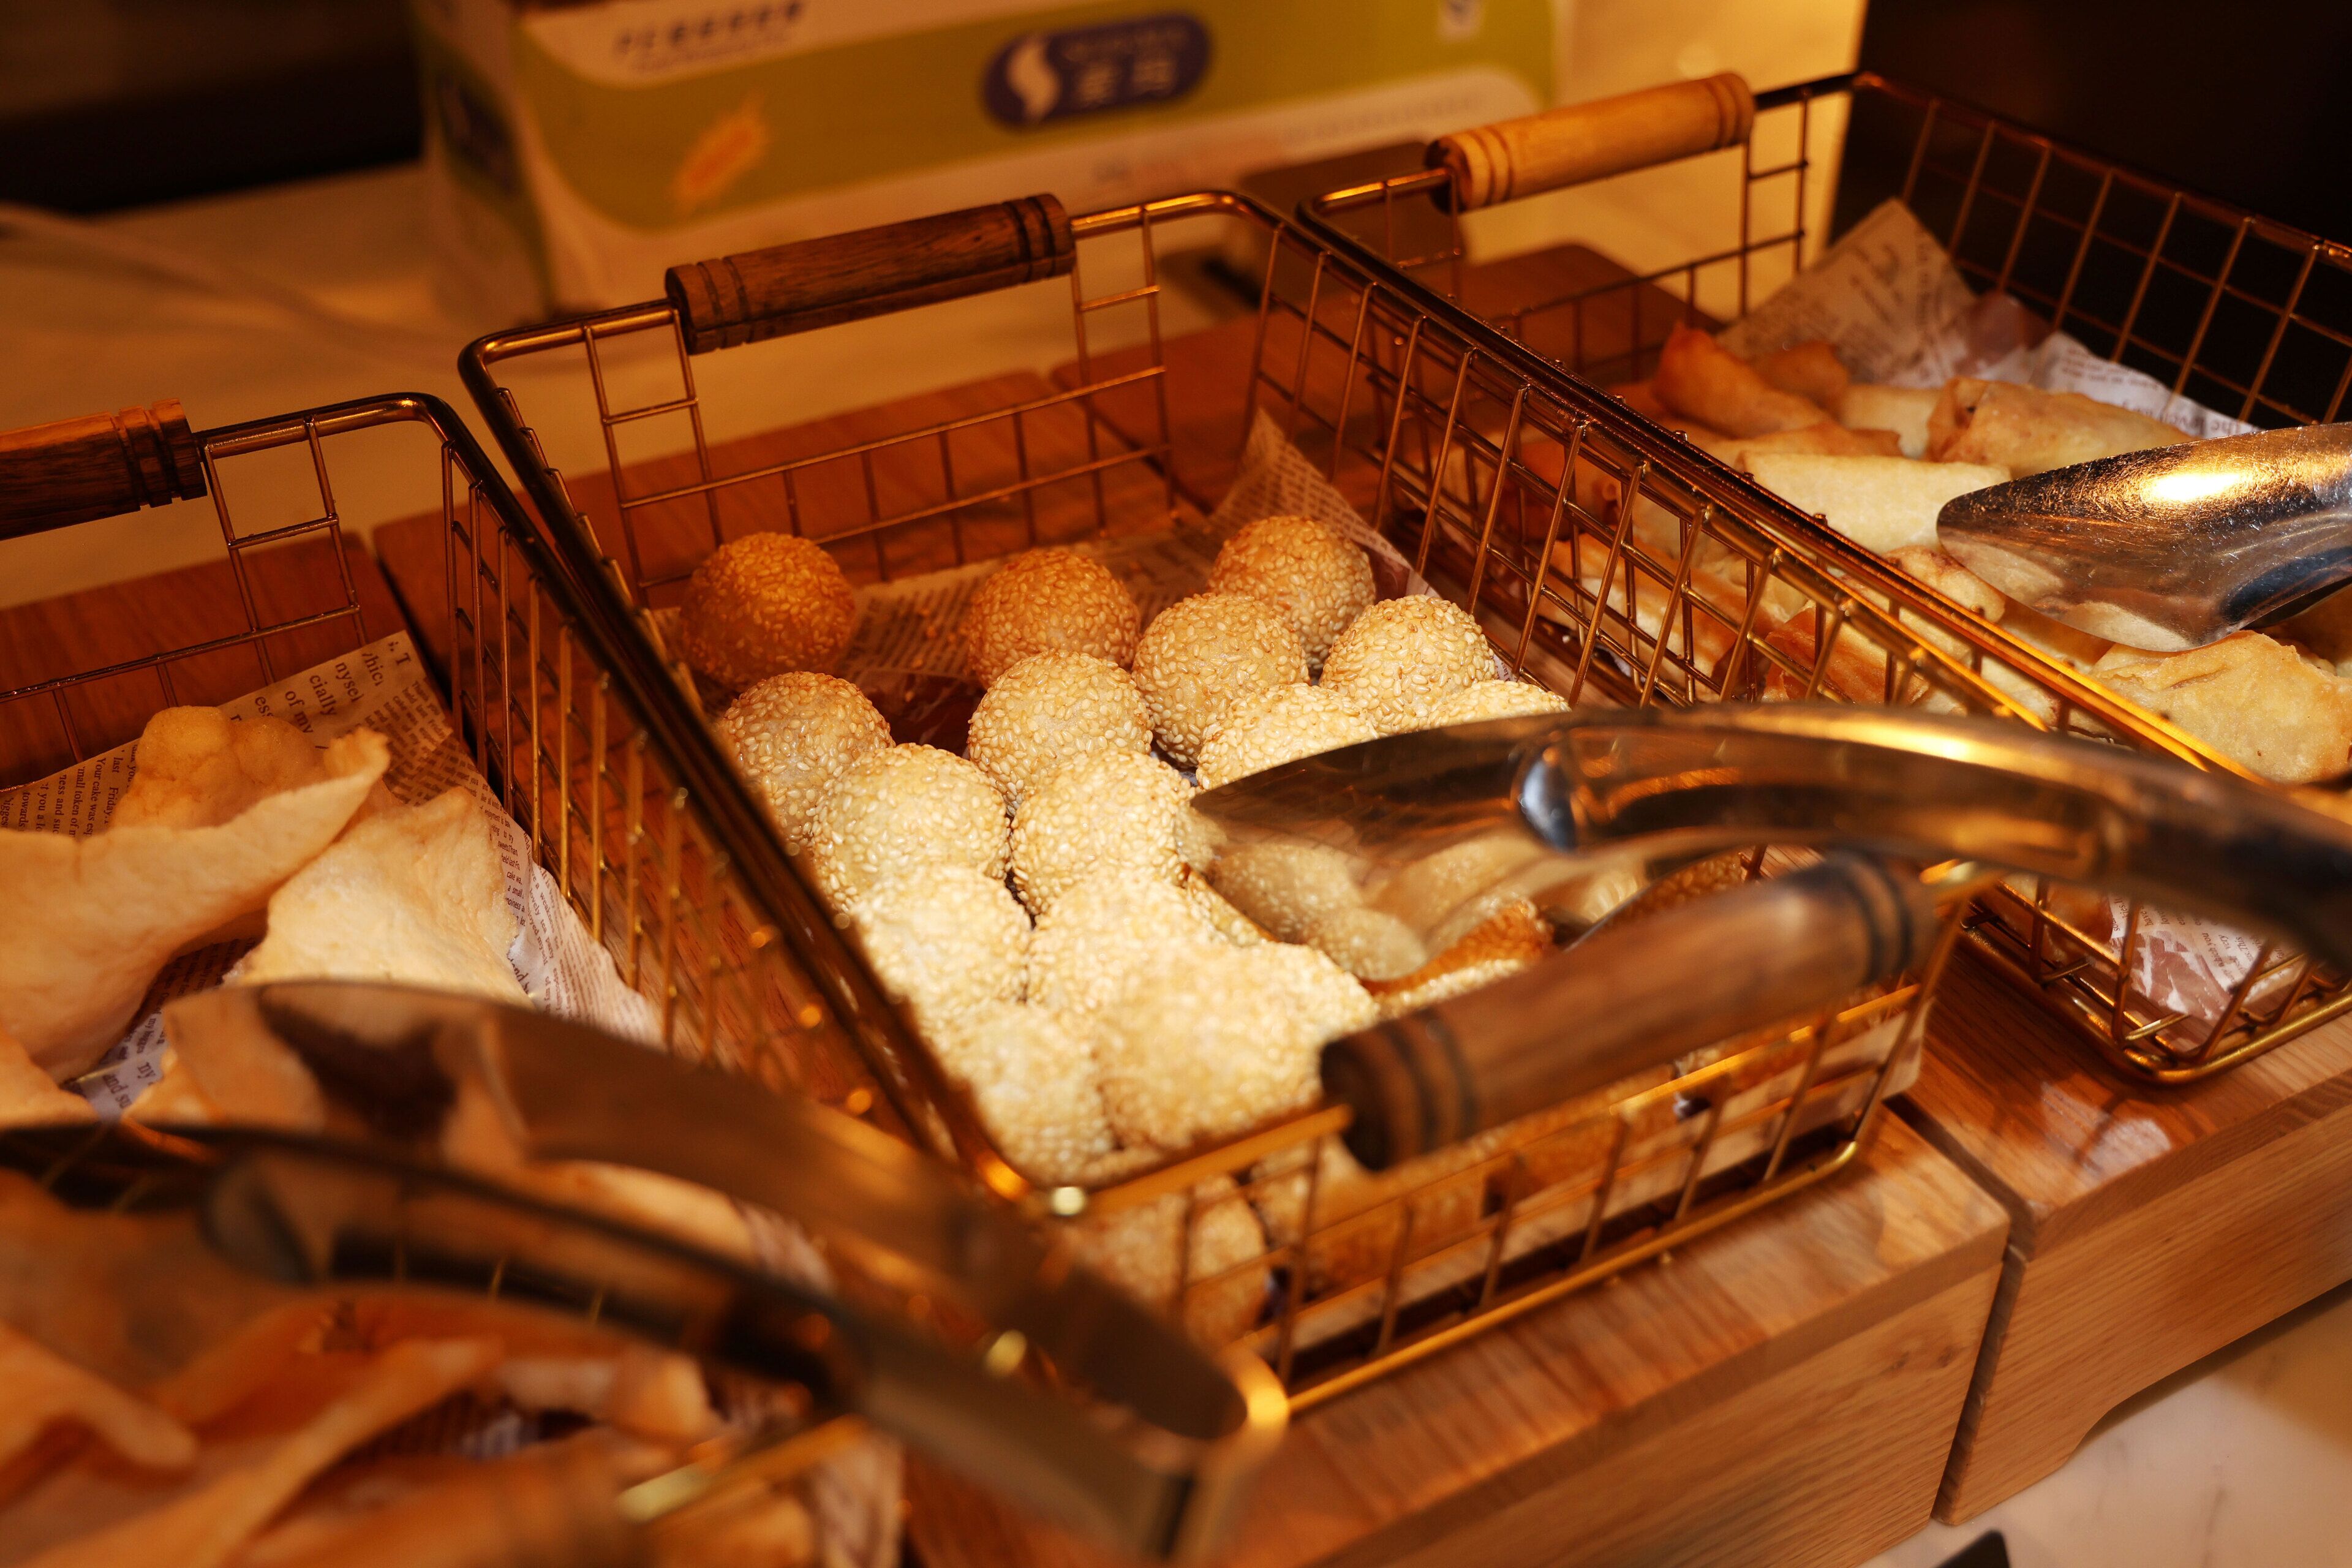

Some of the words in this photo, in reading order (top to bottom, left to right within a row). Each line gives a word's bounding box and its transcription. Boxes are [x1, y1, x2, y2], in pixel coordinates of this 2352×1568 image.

[284, 690, 304, 707] of
[309, 674, 336, 717] cially
[76, 766, 86, 788] mall
[94, 757, 107, 780] Your
[91, 781, 102, 802] cake
[18, 792, 31, 827] towards
[37, 793, 47, 811] you
[55, 797, 64, 816] and
[72, 791, 84, 815] token
[88, 804, 97, 821] was
[70, 818, 80, 829] of
[507, 871, 515, 881] cake
